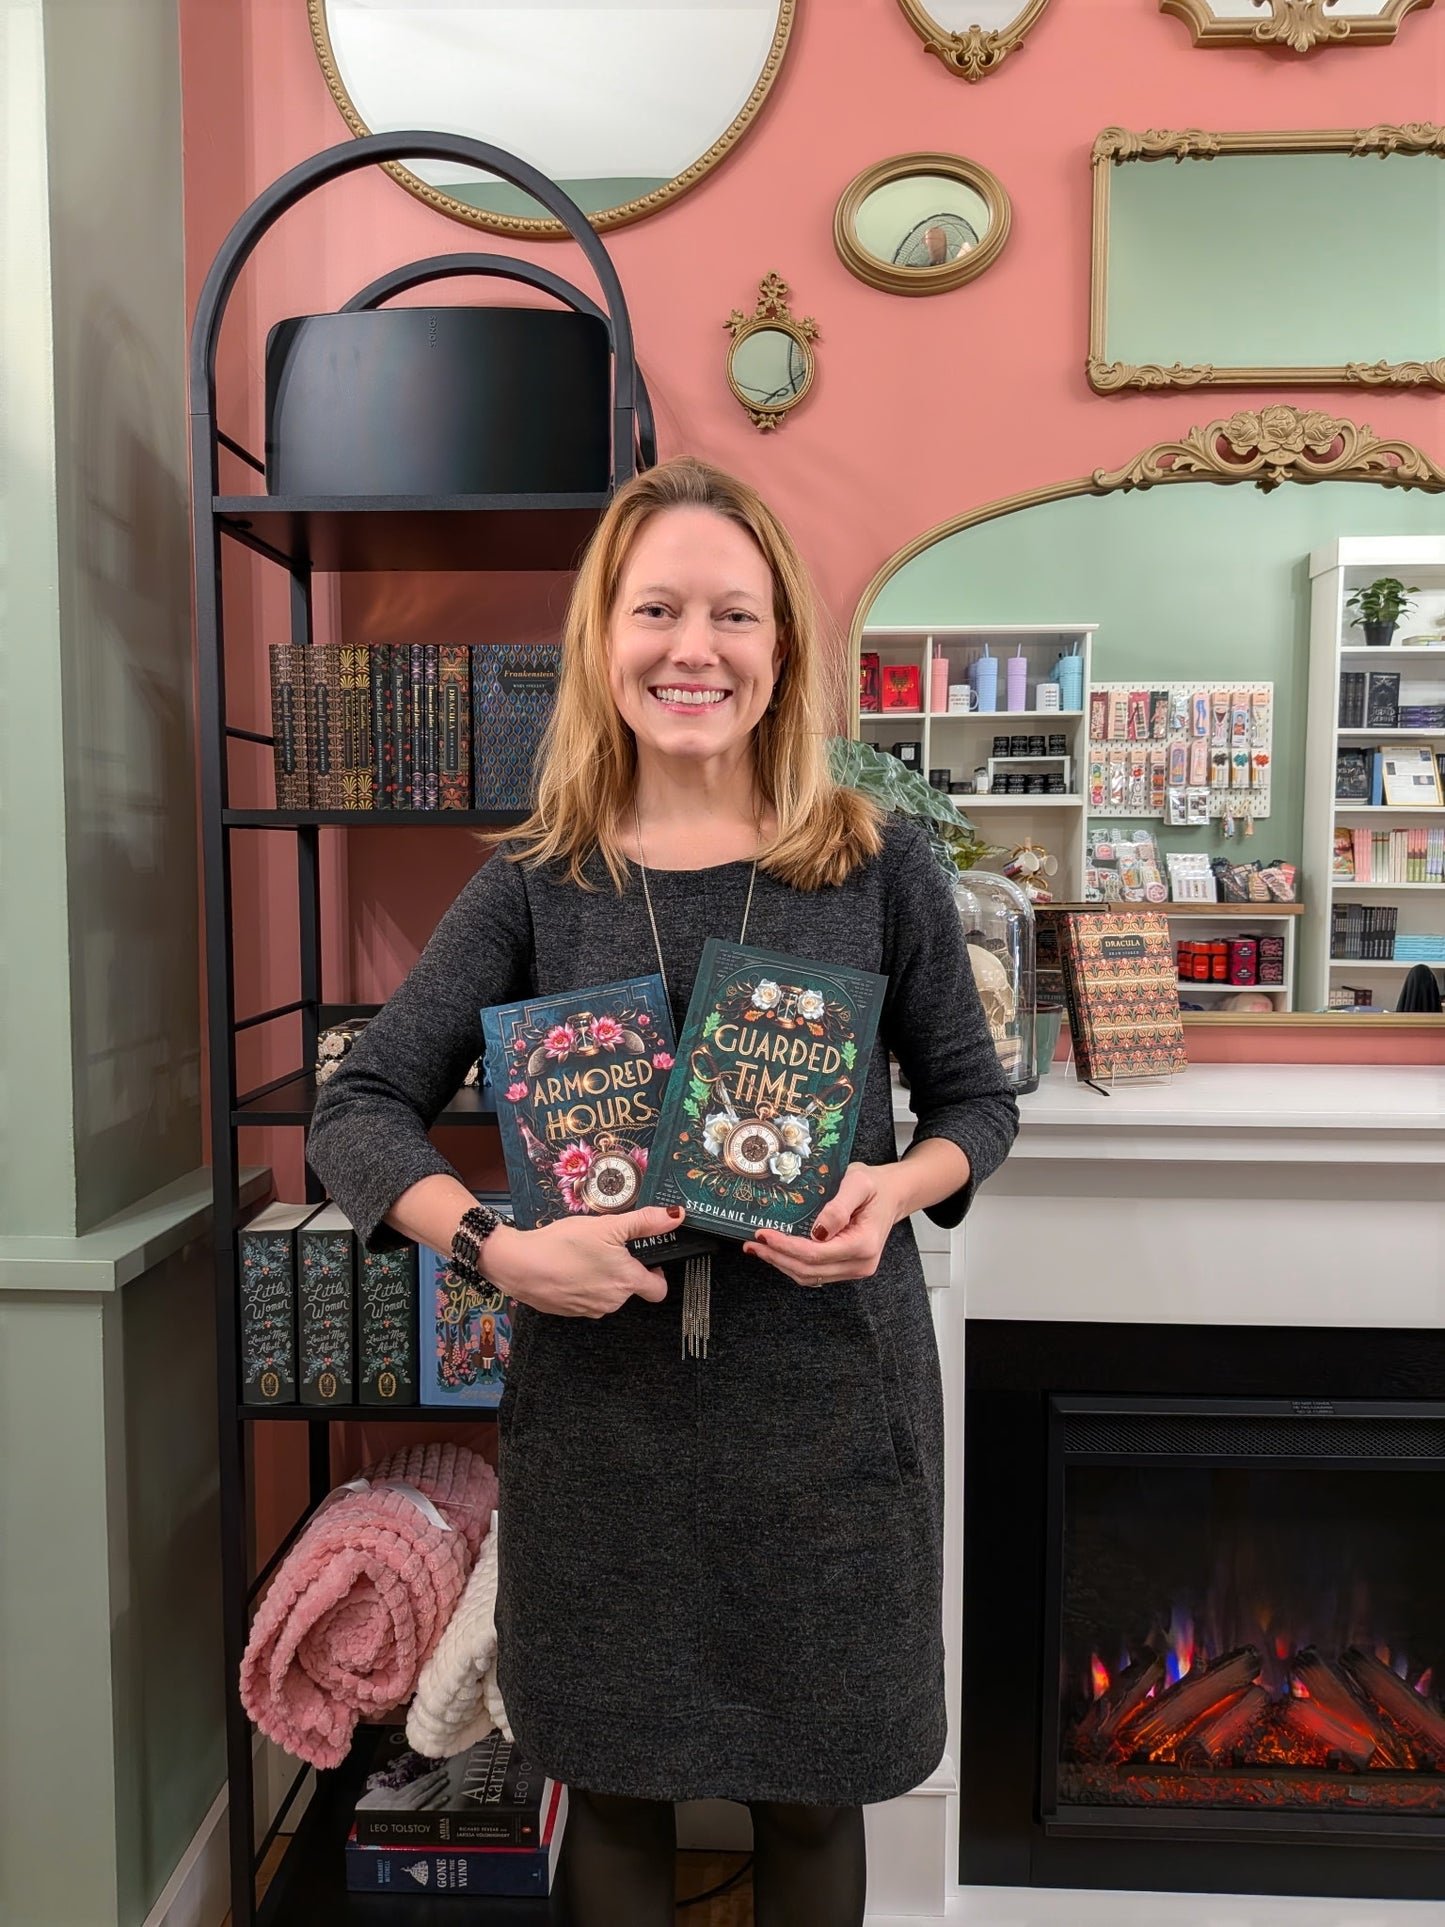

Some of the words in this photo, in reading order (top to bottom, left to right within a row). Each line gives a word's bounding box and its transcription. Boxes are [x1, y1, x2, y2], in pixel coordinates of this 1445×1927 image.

[428, 314, 438, 349] SONOS
[504, 670, 554, 678] Frankenstein
[1105, 939, 1141, 948] DRACULA
[714, 1023, 841, 1074] GUARDED
[534, 1059, 653, 1107] ARMORED
[735, 1060, 809, 1114] TIME
[547, 1091, 652, 1140] HOURS
[686, 1200, 745, 1223] STEPHANIE
[750, 1215, 794, 1234] HANSEN
[634, 1232, 677, 1250] HANSEN
[249, 1281, 286, 1302] Little
[307, 1281, 345, 1302] Little
[368, 1281, 404, 1302] Little
[244, 1299, 291, 1319] Women
[303, 1299, 350, 1319] Women
[364, 1299, 410, 1318] Women
[269, 1329, 291, 1343] May
[328, 1329, 349, 1343] May
[387, 1329, 409, 1343] May
[513, 1781, 529, 1805] LEO
[370, 1823, 388, 1833] LEO
[391, 1823, 431, 1833] TOLSTOY
[436, 1858, 447, 1888] GONE
[457, 1858, 468, 1888] WIND
